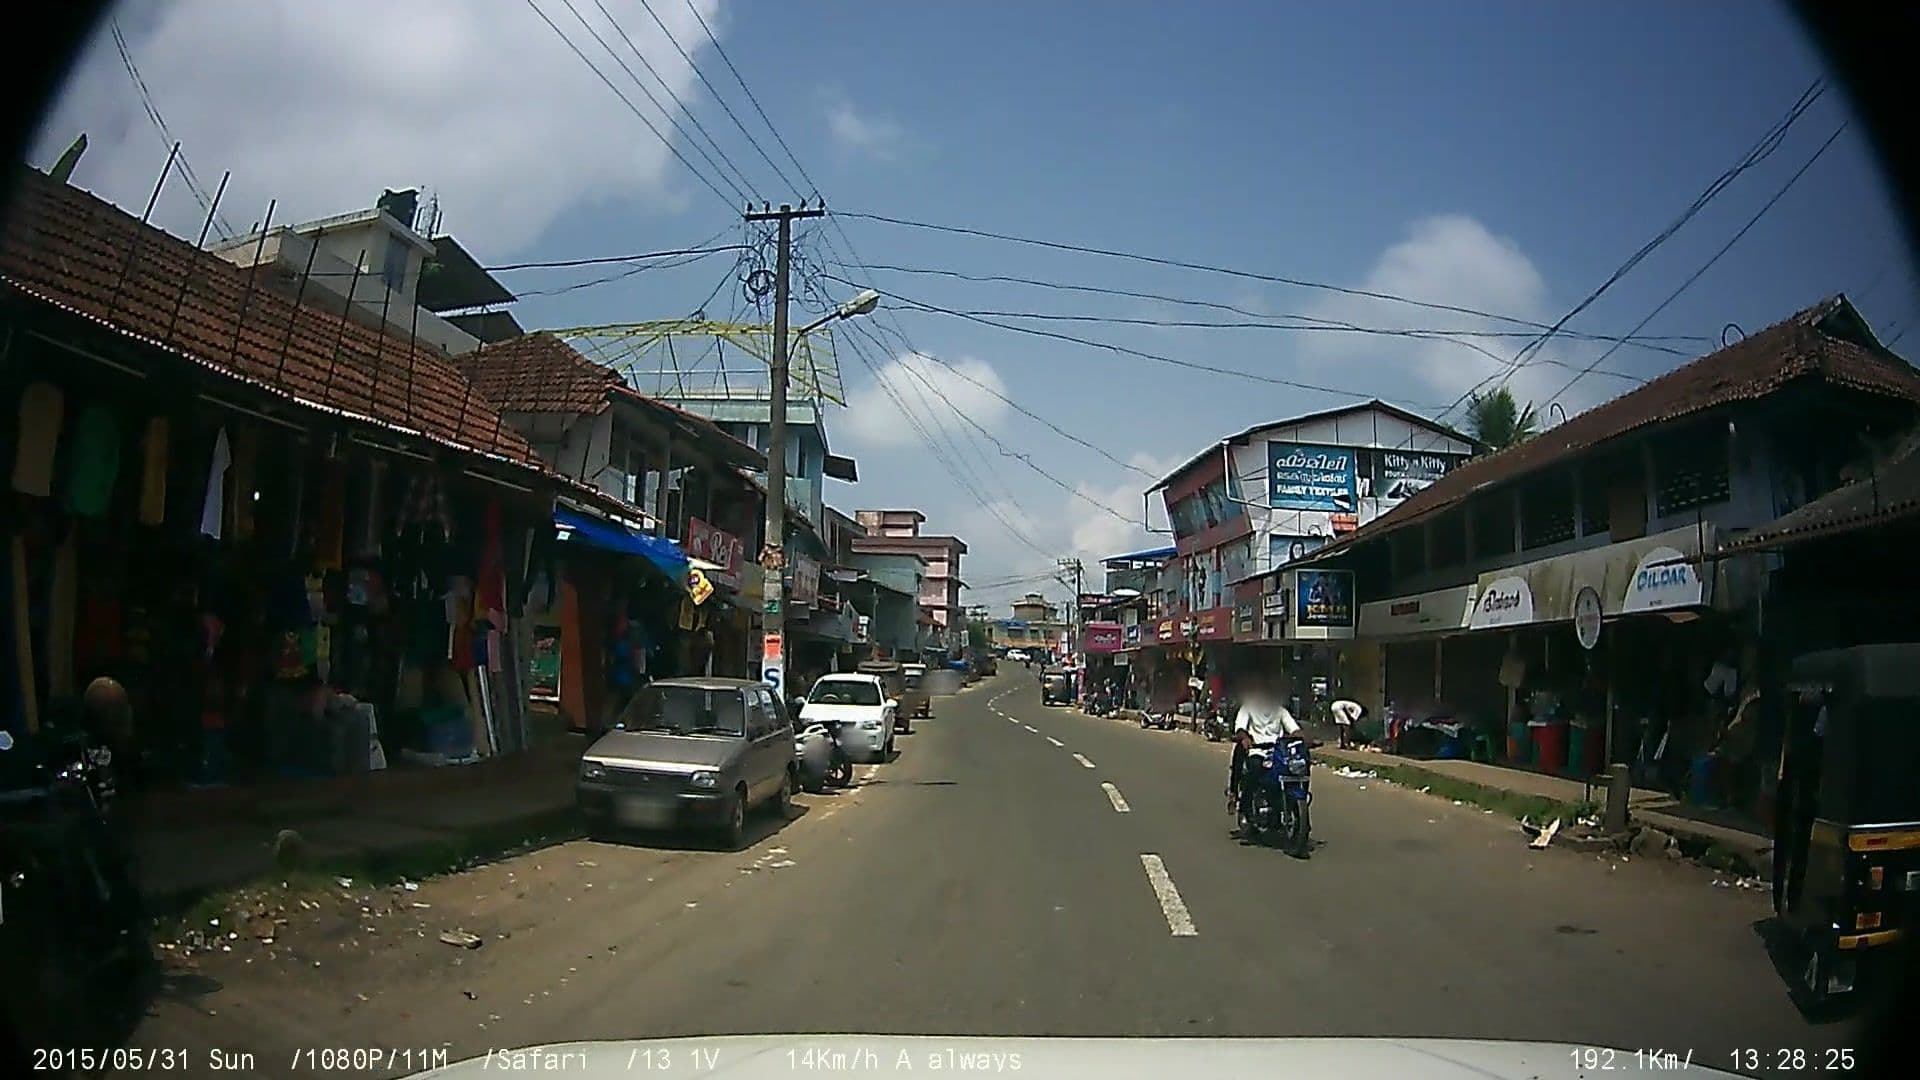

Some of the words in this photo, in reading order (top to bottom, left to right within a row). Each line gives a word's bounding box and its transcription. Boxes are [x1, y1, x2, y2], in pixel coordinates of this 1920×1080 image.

[1384, 454, 1409, 471] Kitty
[1420, 456, 1446, 473] Kitty
[1276, 485, 1307, 495] FAMILY
